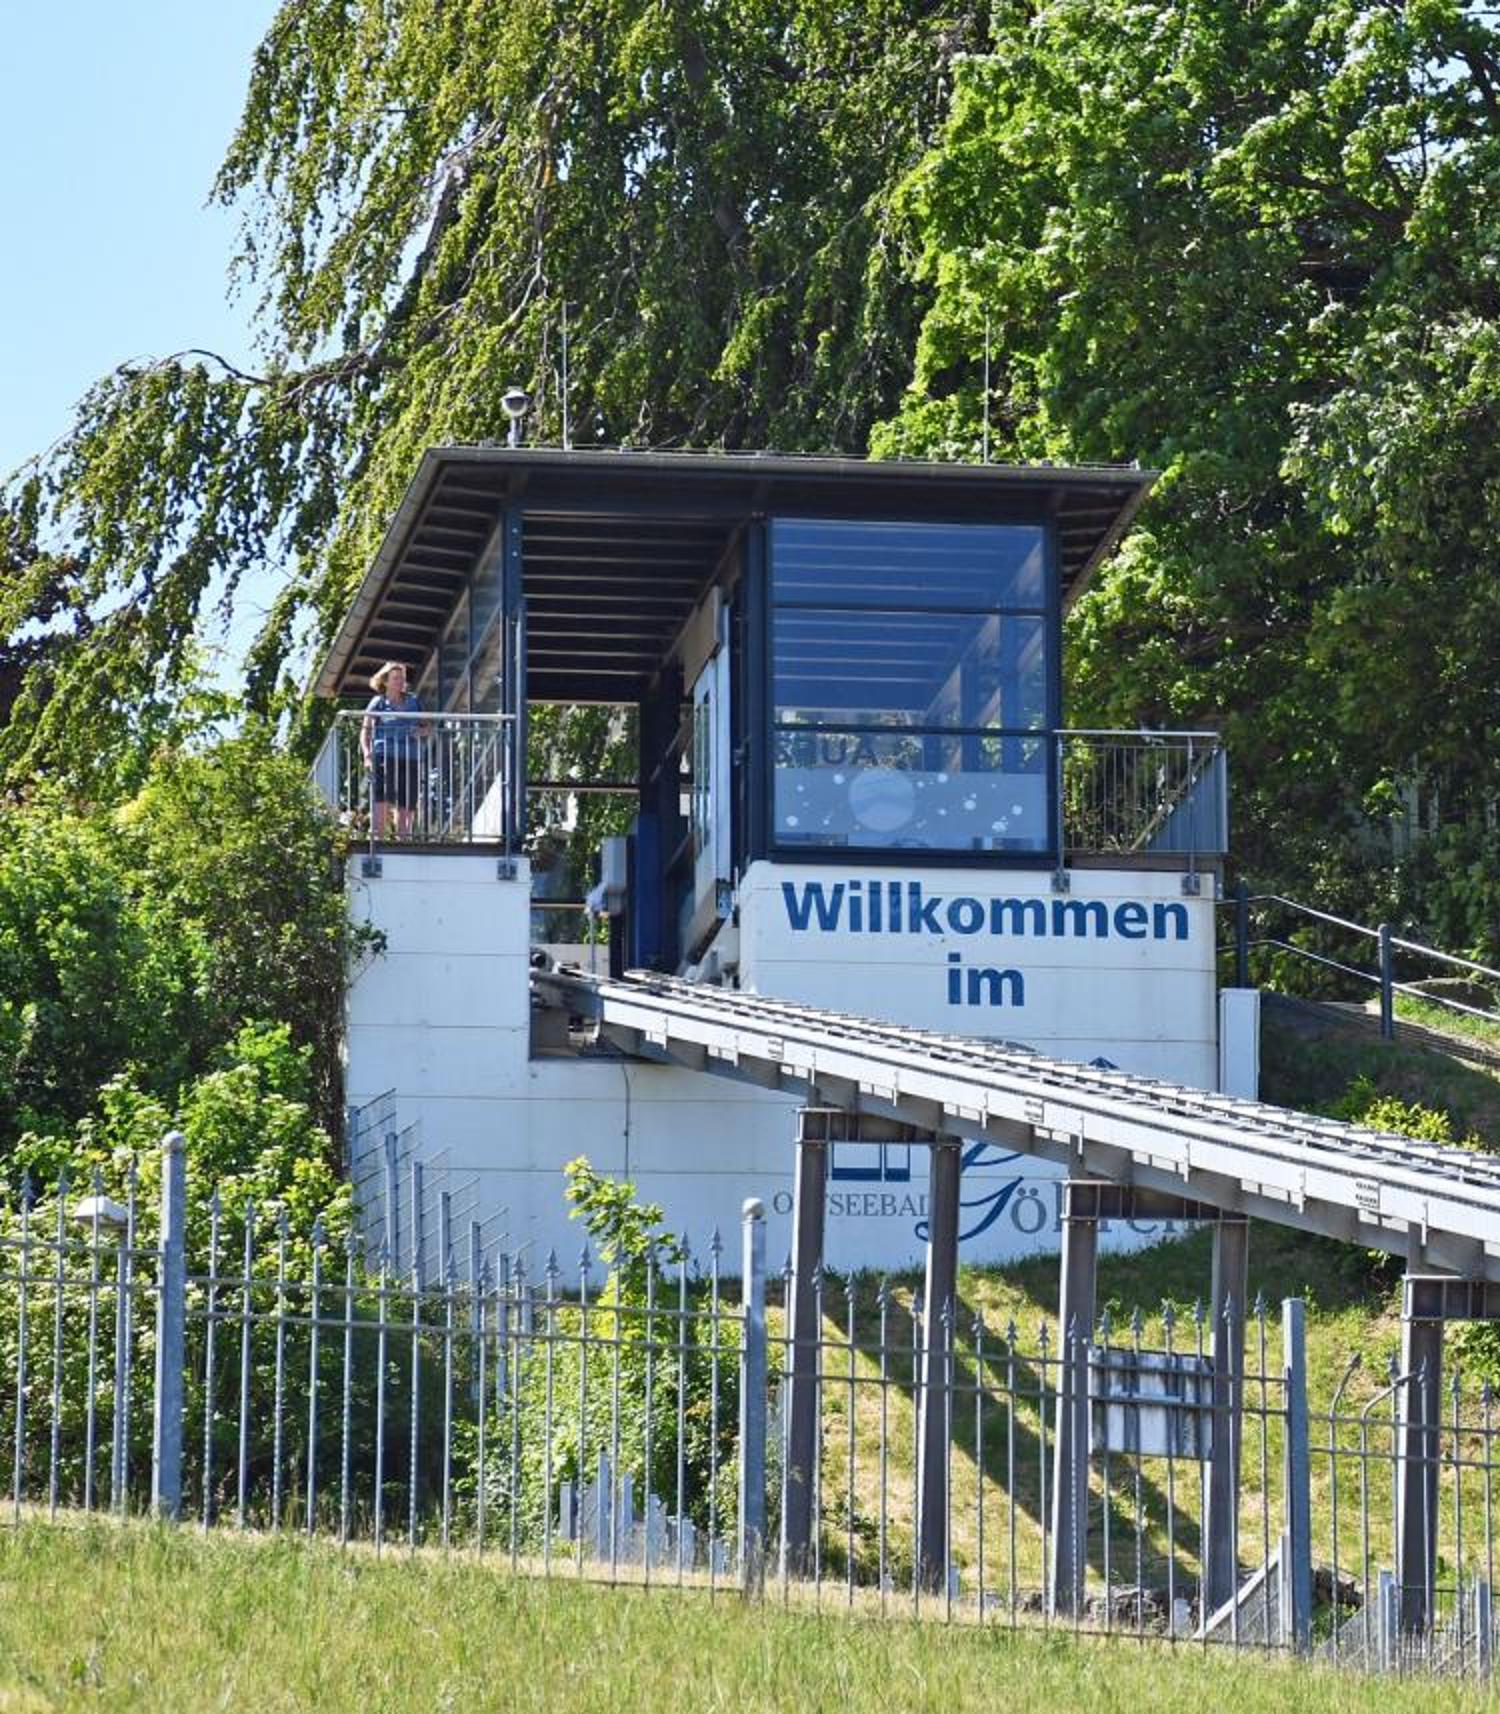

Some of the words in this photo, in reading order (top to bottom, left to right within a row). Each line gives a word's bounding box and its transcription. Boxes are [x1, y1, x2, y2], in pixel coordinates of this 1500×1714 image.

[782, 880, 1189, 940] Willkommen
[947, 952, 1025, 1007] im
[773, 1191, 932, 1217] OSEEBA
